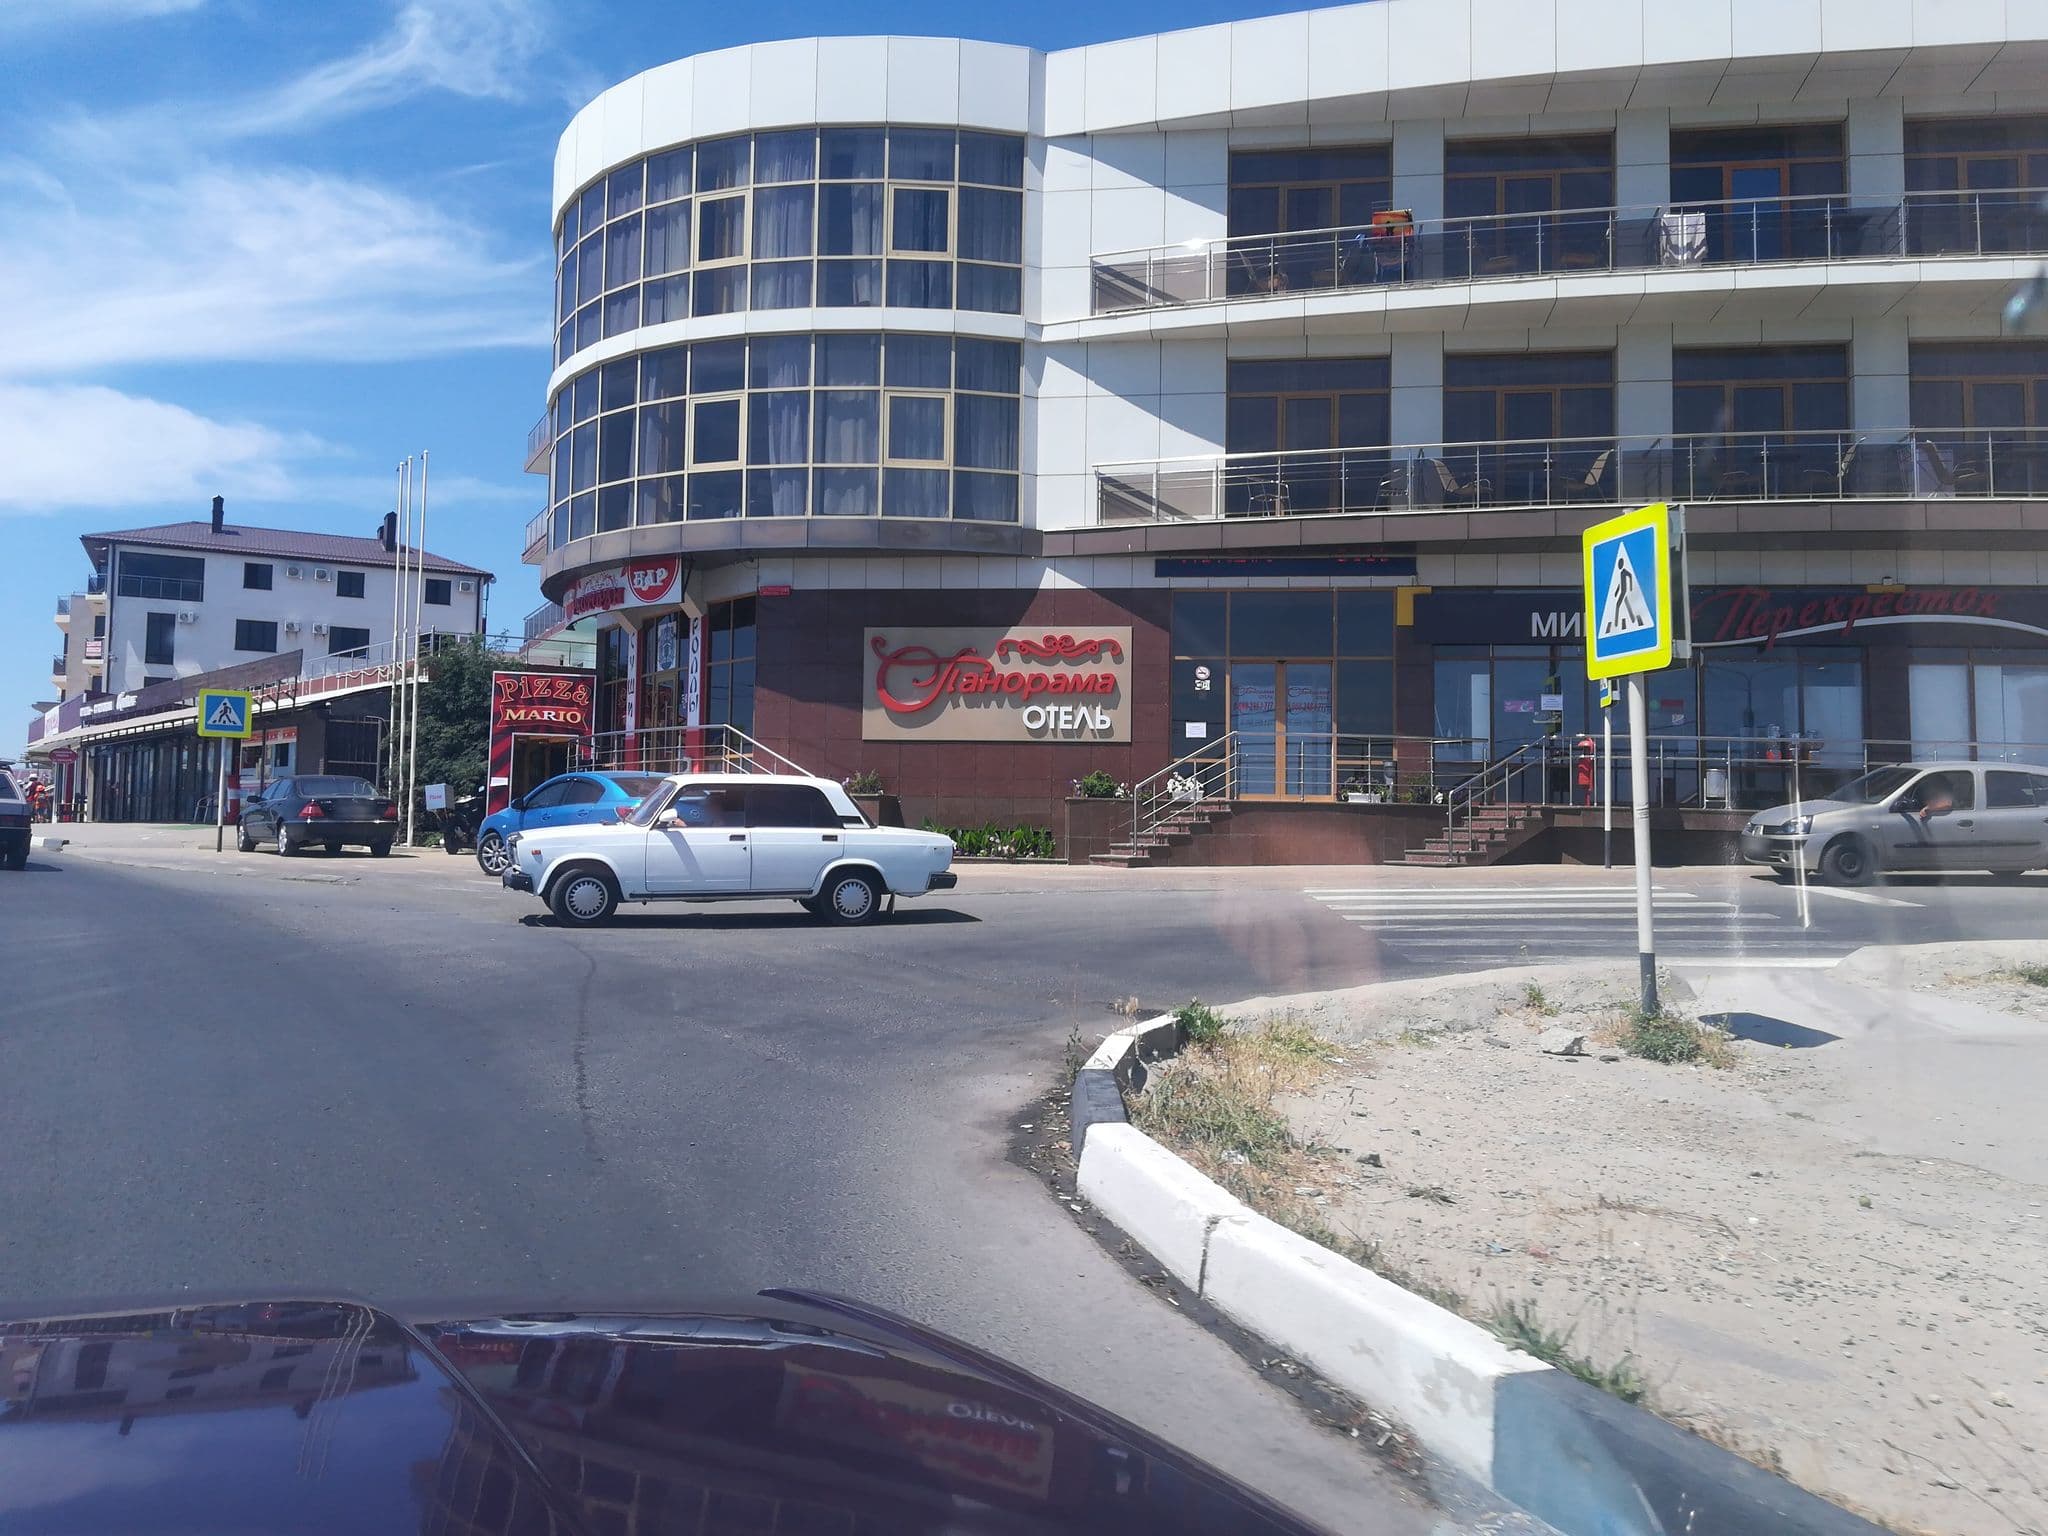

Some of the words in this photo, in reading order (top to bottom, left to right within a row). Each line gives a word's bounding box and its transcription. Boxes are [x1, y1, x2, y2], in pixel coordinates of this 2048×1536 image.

[1531, 611, 1586, 638] МИ
[871, 636, 1118, 713] Панорама
[496, 676, 592, 705] Pizza
[505, 708, 581, 723] MARIO
[1022, 705, 1112, 730] ОТЕЛЬ
